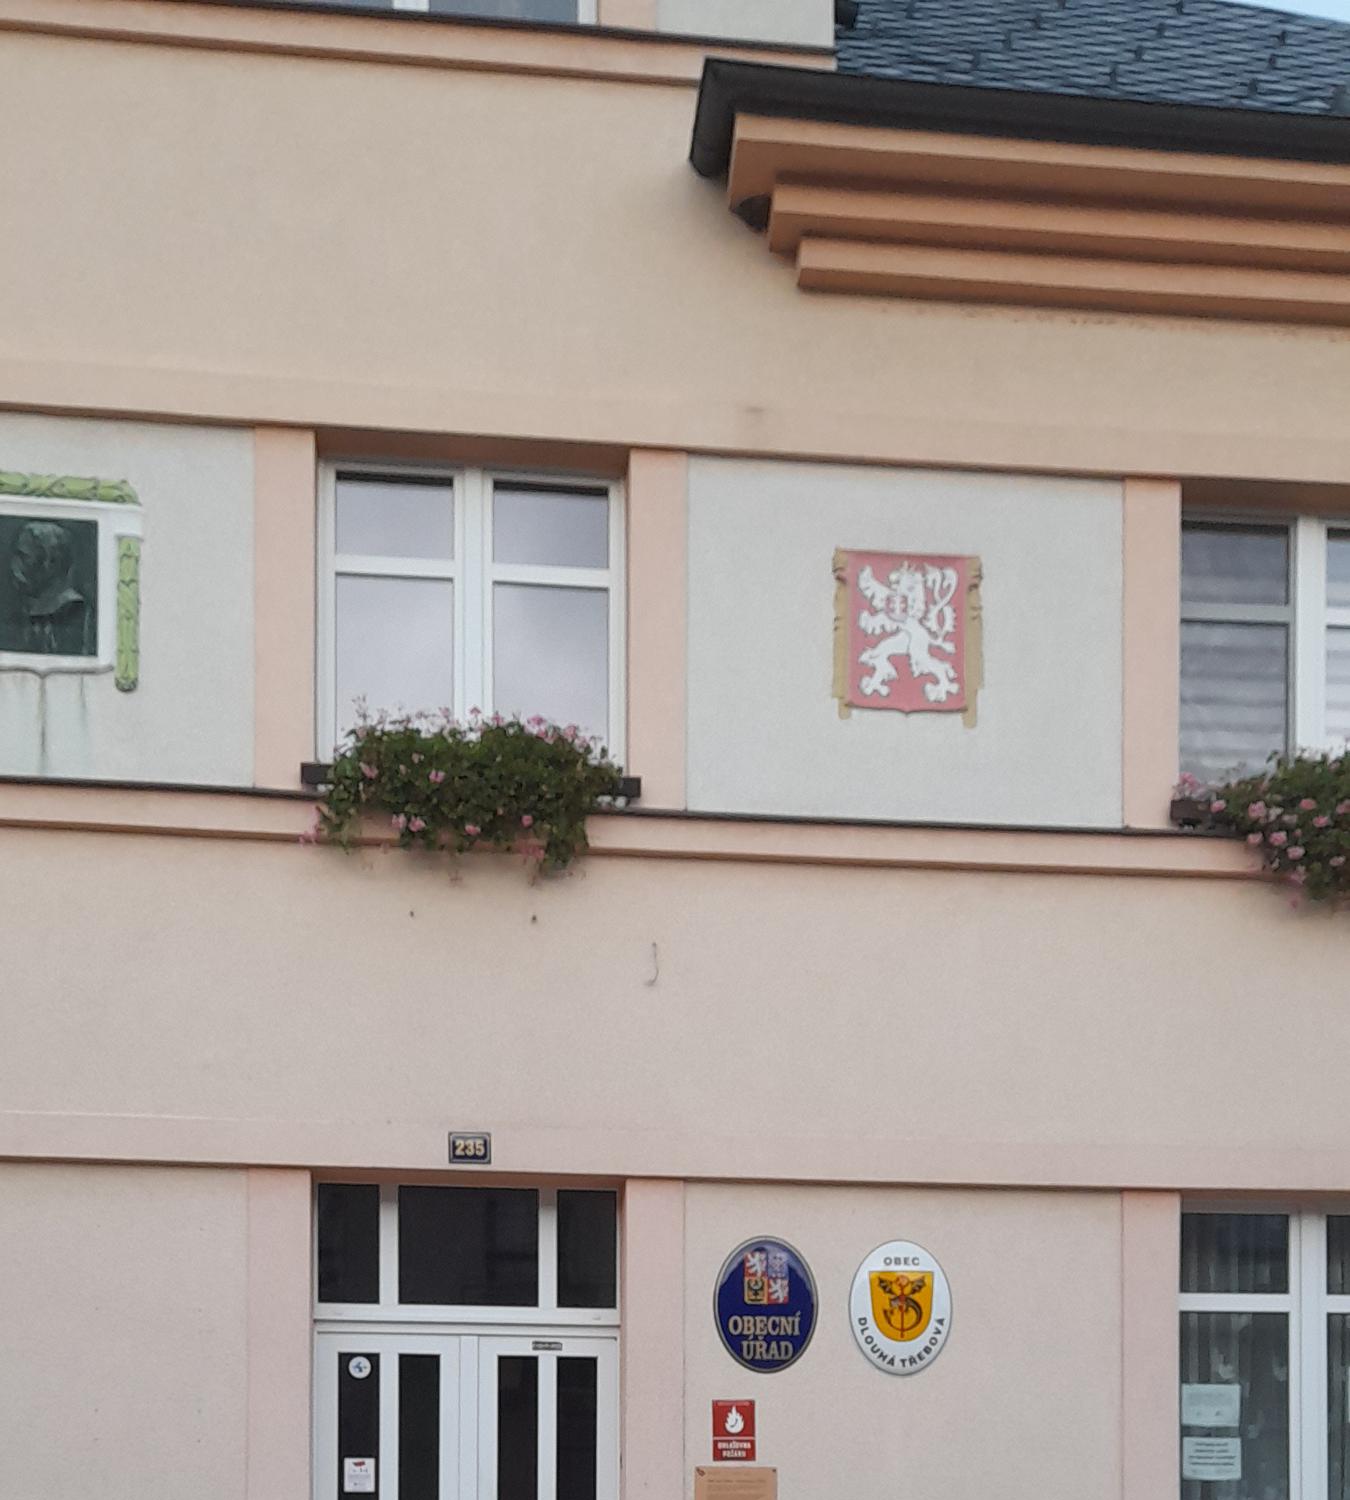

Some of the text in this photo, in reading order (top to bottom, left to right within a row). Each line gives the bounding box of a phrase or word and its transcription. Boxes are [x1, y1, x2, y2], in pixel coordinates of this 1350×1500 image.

[455, 1139, 485, 1156] 235
[883, 1256, 920, 1267] OBEC
[728, 1310, 801, 1336] OBECNÍ
[741, 1335, 793, 1360] ÚŘAD
[858, 1317, 895, 1367] DLOUHÁ
